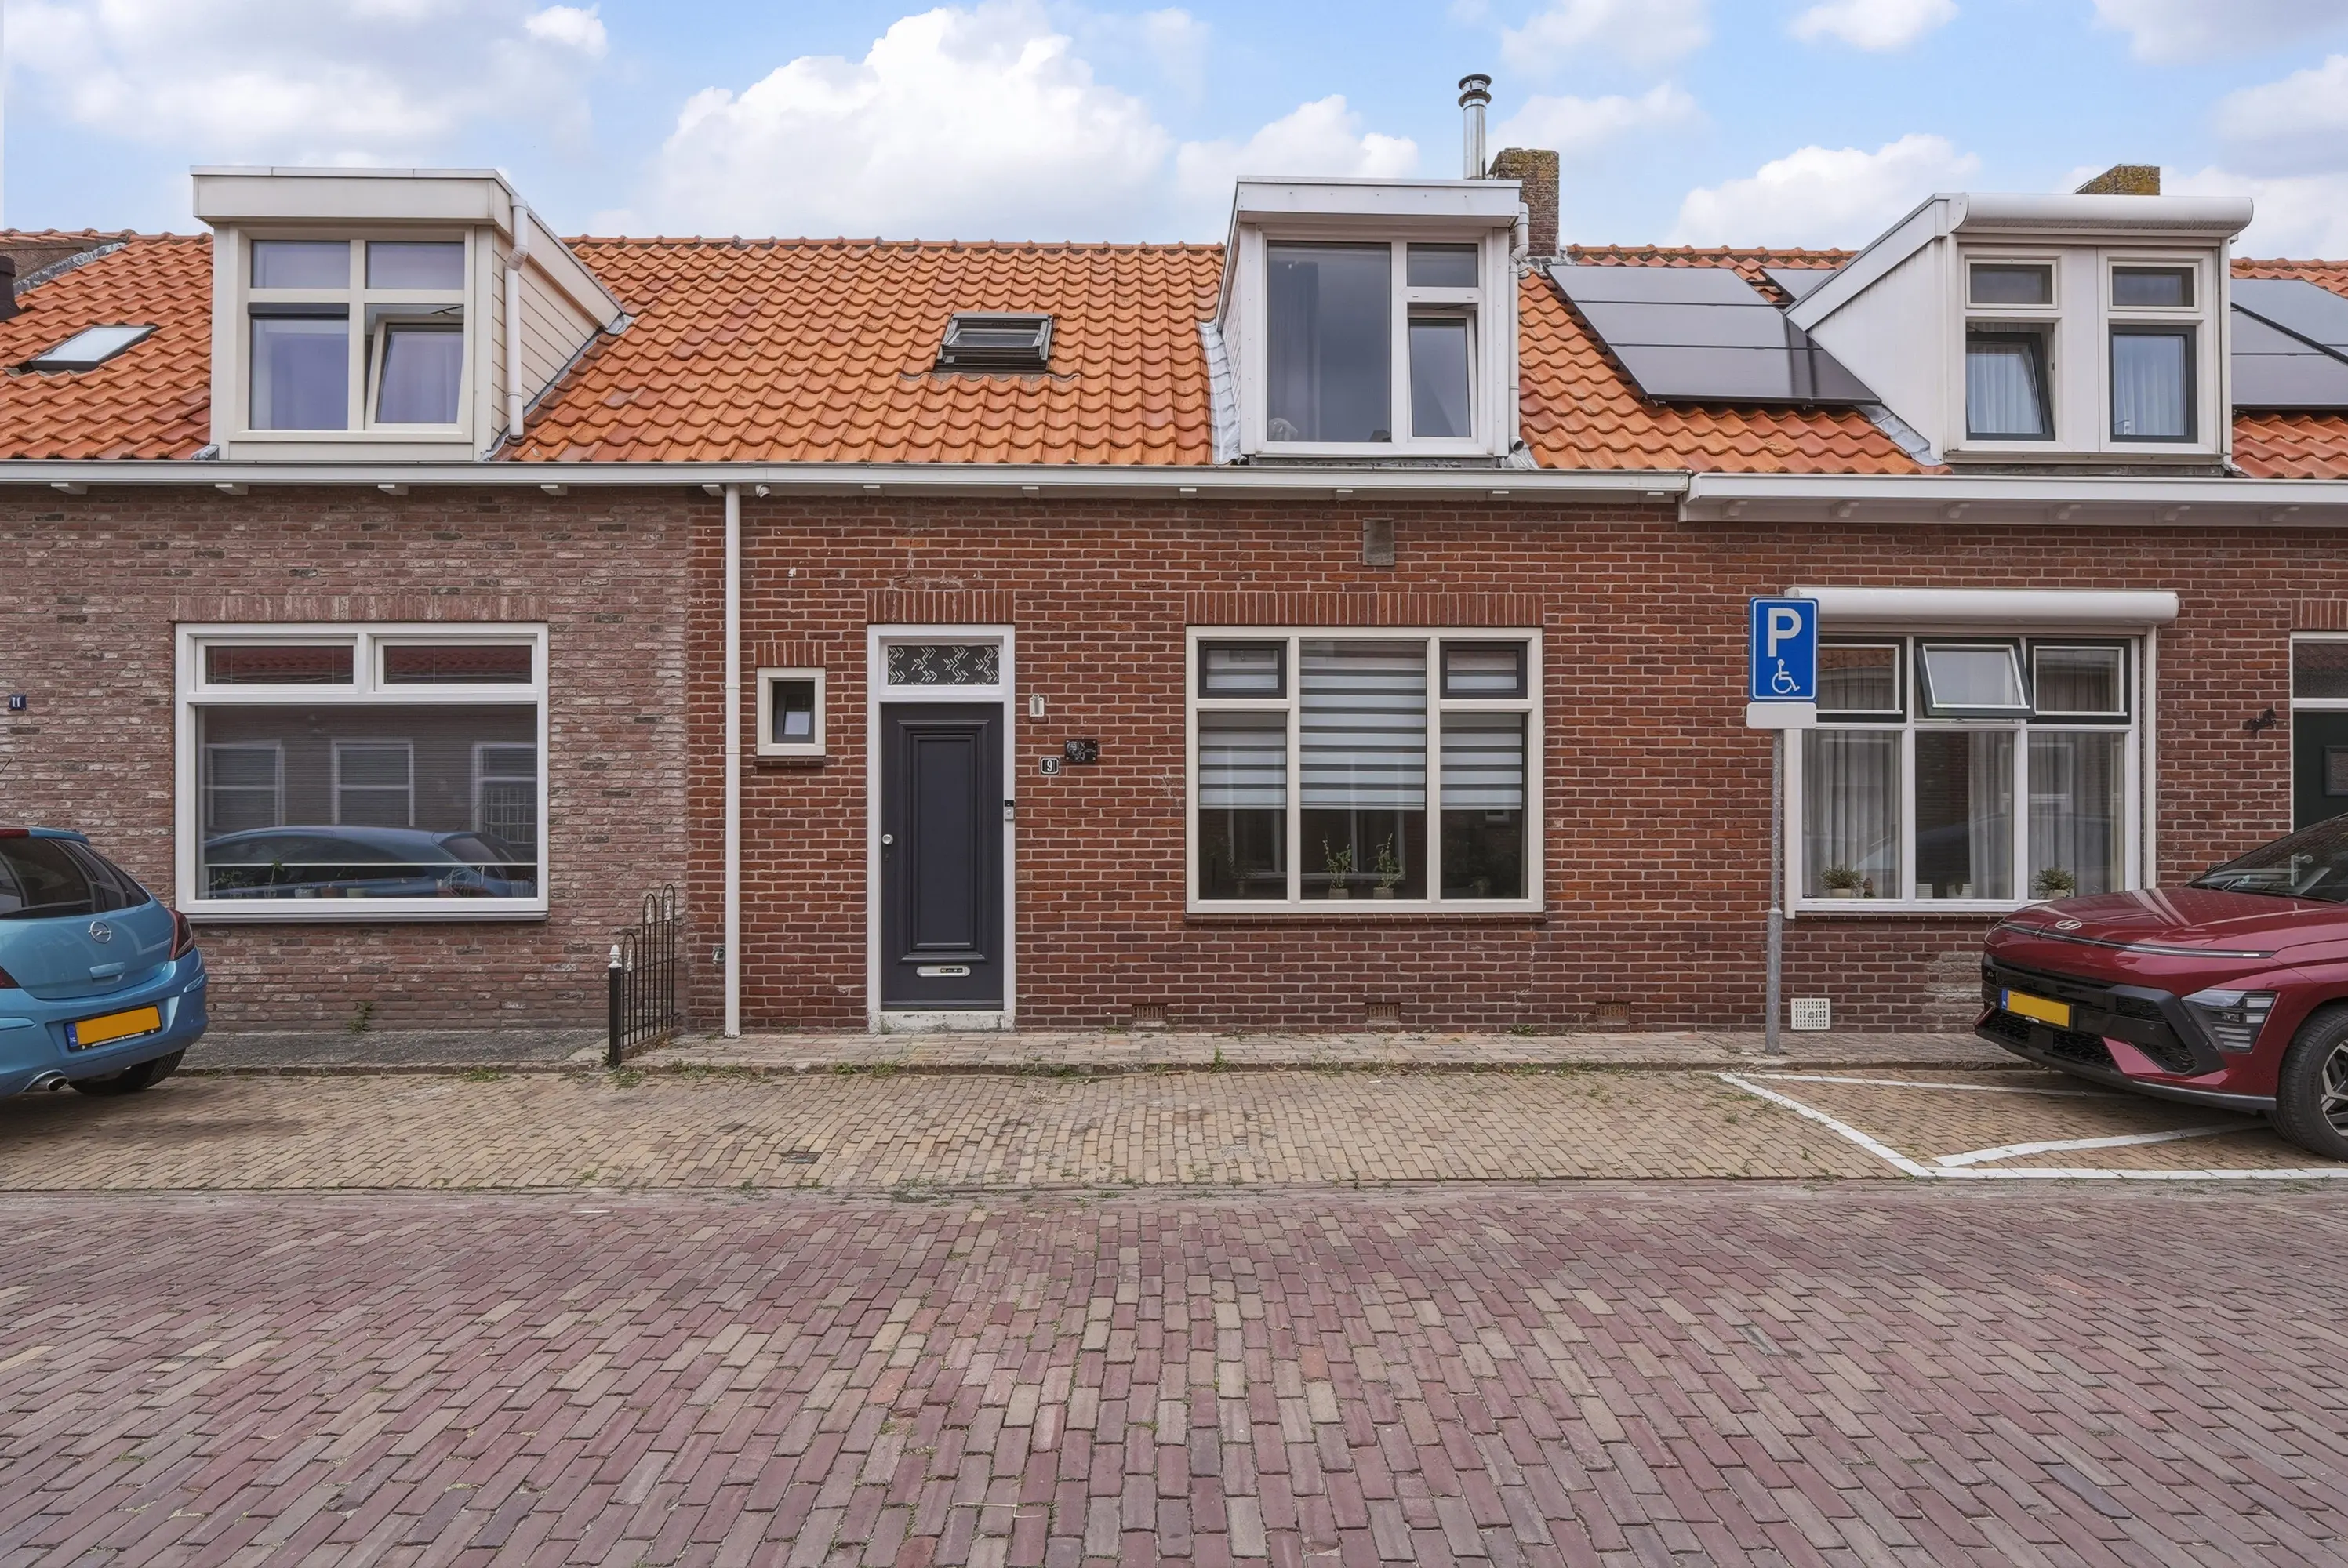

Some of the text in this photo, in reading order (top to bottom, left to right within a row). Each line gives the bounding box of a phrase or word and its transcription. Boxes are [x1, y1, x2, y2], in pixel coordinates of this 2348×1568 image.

[1767, 607, 1803, 658] P
[12, 696, 21, 707] 11
[1046, 760, 1053, 772] 9
